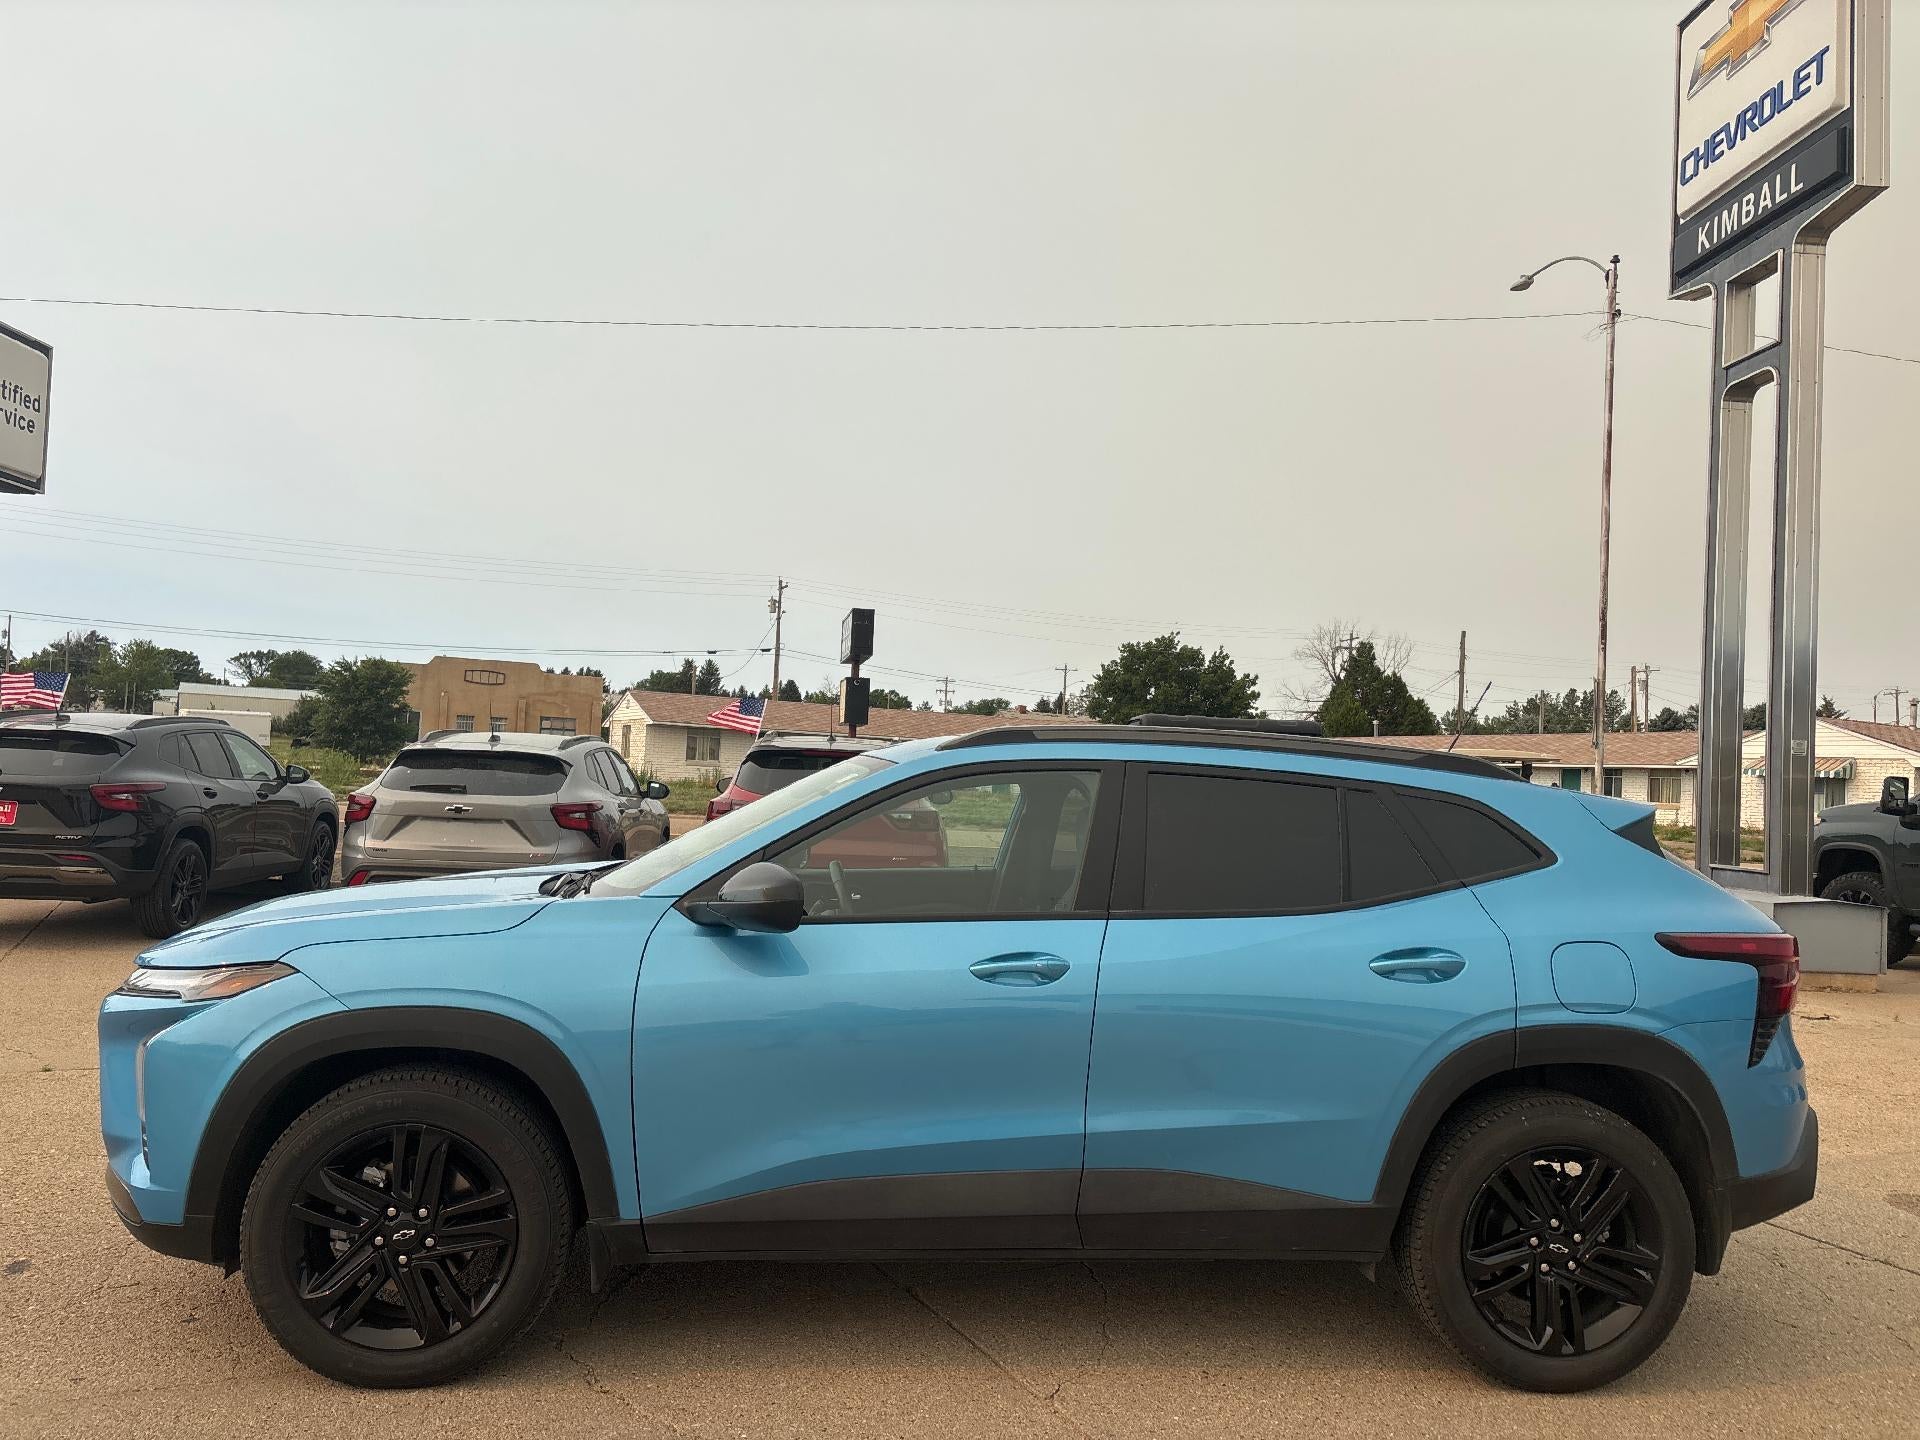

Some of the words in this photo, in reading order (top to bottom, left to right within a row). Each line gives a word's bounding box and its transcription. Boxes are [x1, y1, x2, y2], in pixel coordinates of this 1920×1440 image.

[1680, 45, 1830, 187] CHEVROLET
[1697, 163, 1804, 254] KIMBALL
[0, 379, 41, 413] tified
